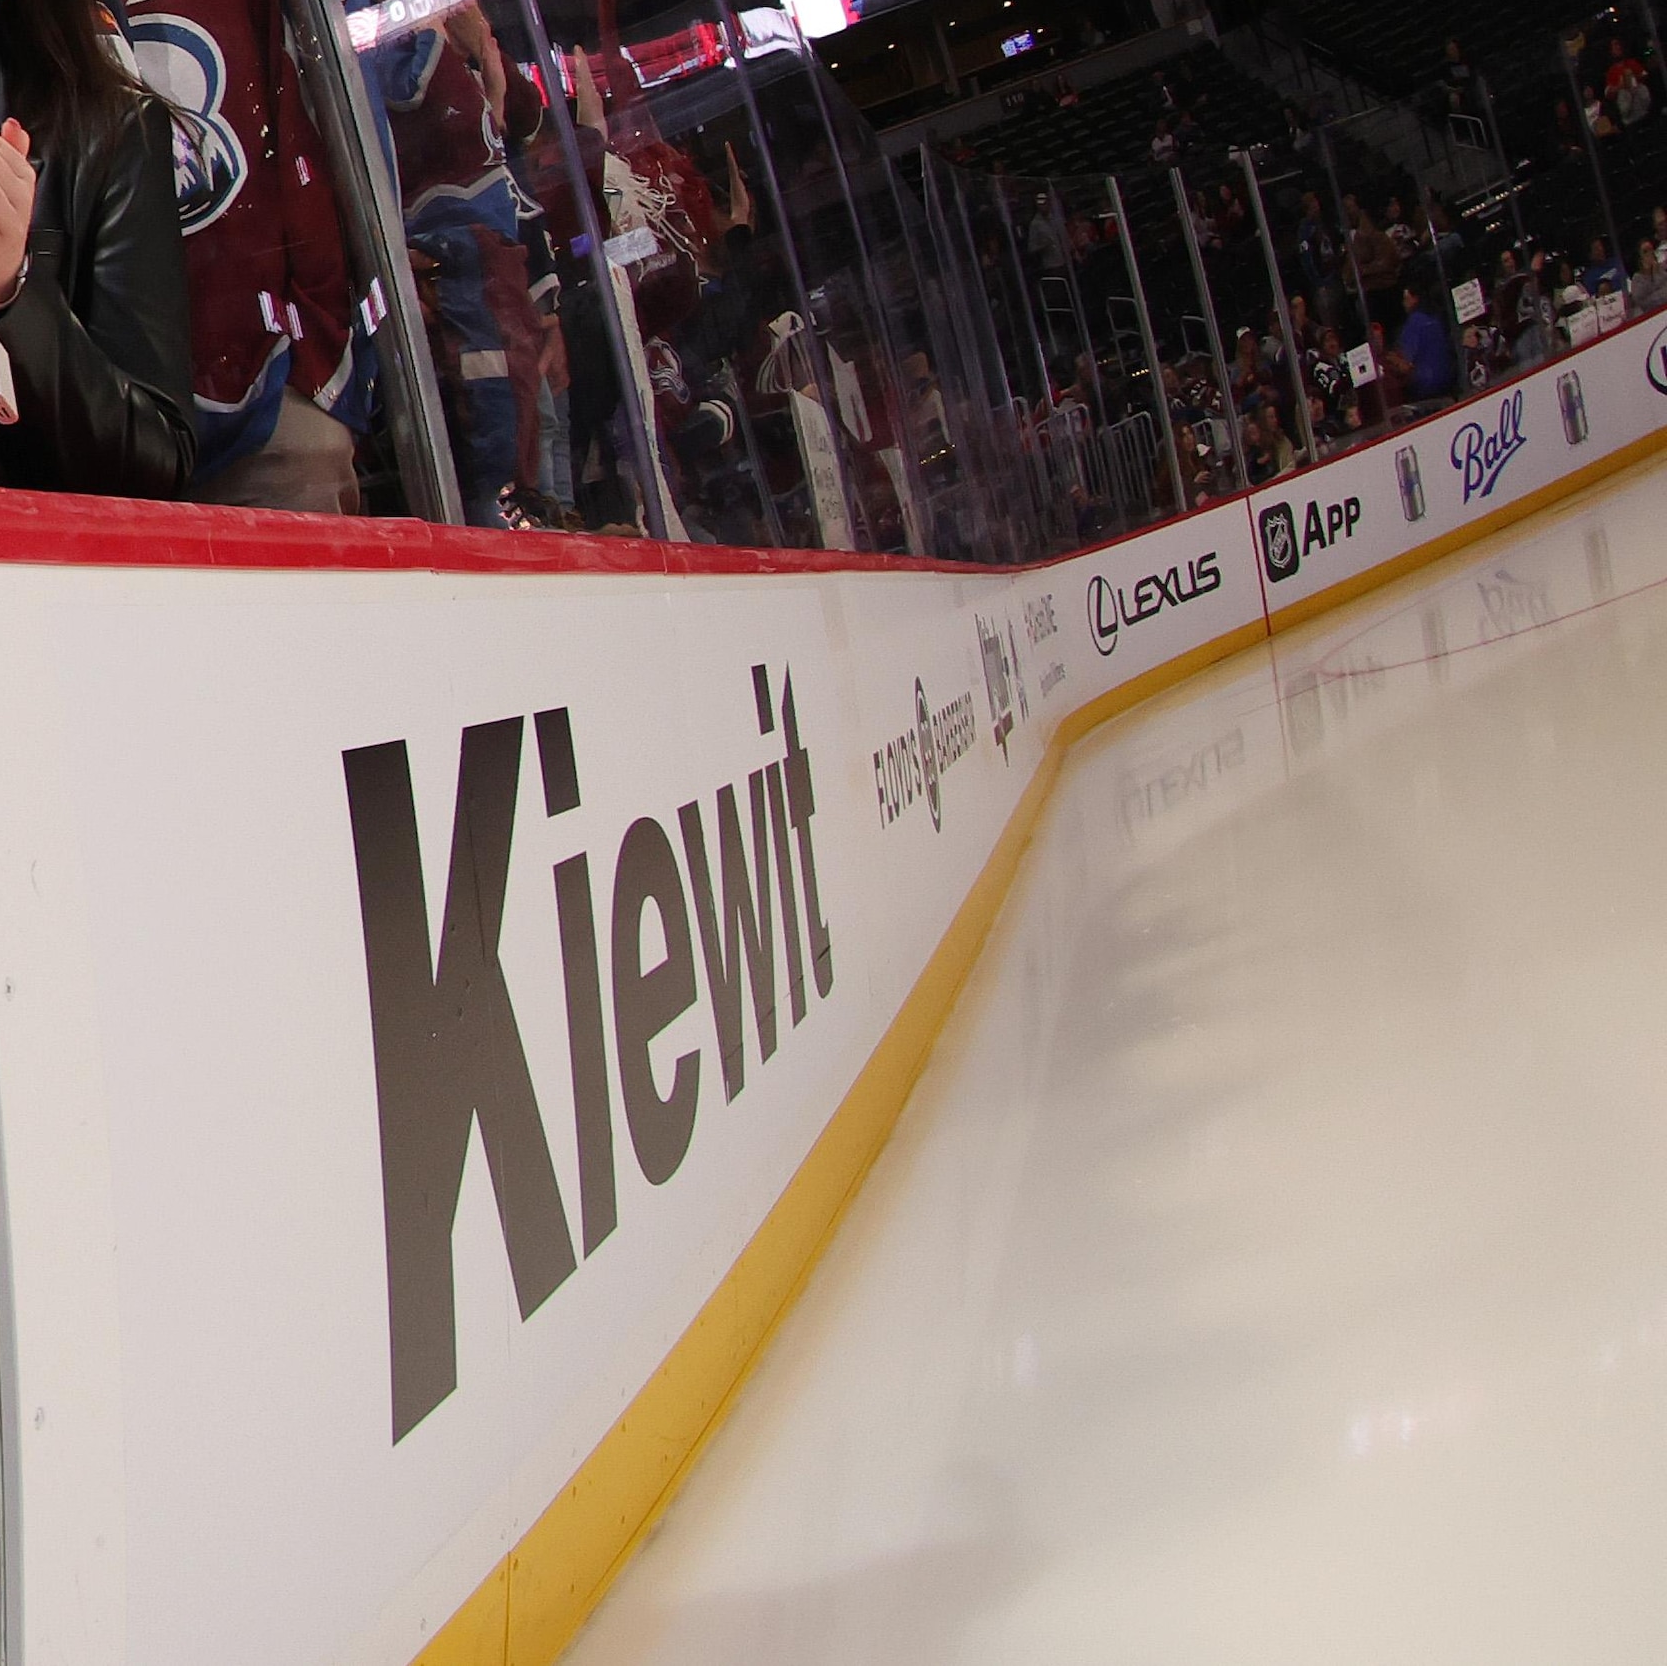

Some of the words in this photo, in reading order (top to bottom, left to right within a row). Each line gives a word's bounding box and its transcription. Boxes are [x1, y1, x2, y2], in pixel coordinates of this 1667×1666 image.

[1450, 389, 1527, 504] Ball
[1117, 551, 1222, 627] LEXUS
[872, 728, 922, 831] FLOYD'S
[341, 662, 835, 1447] Kiewit
